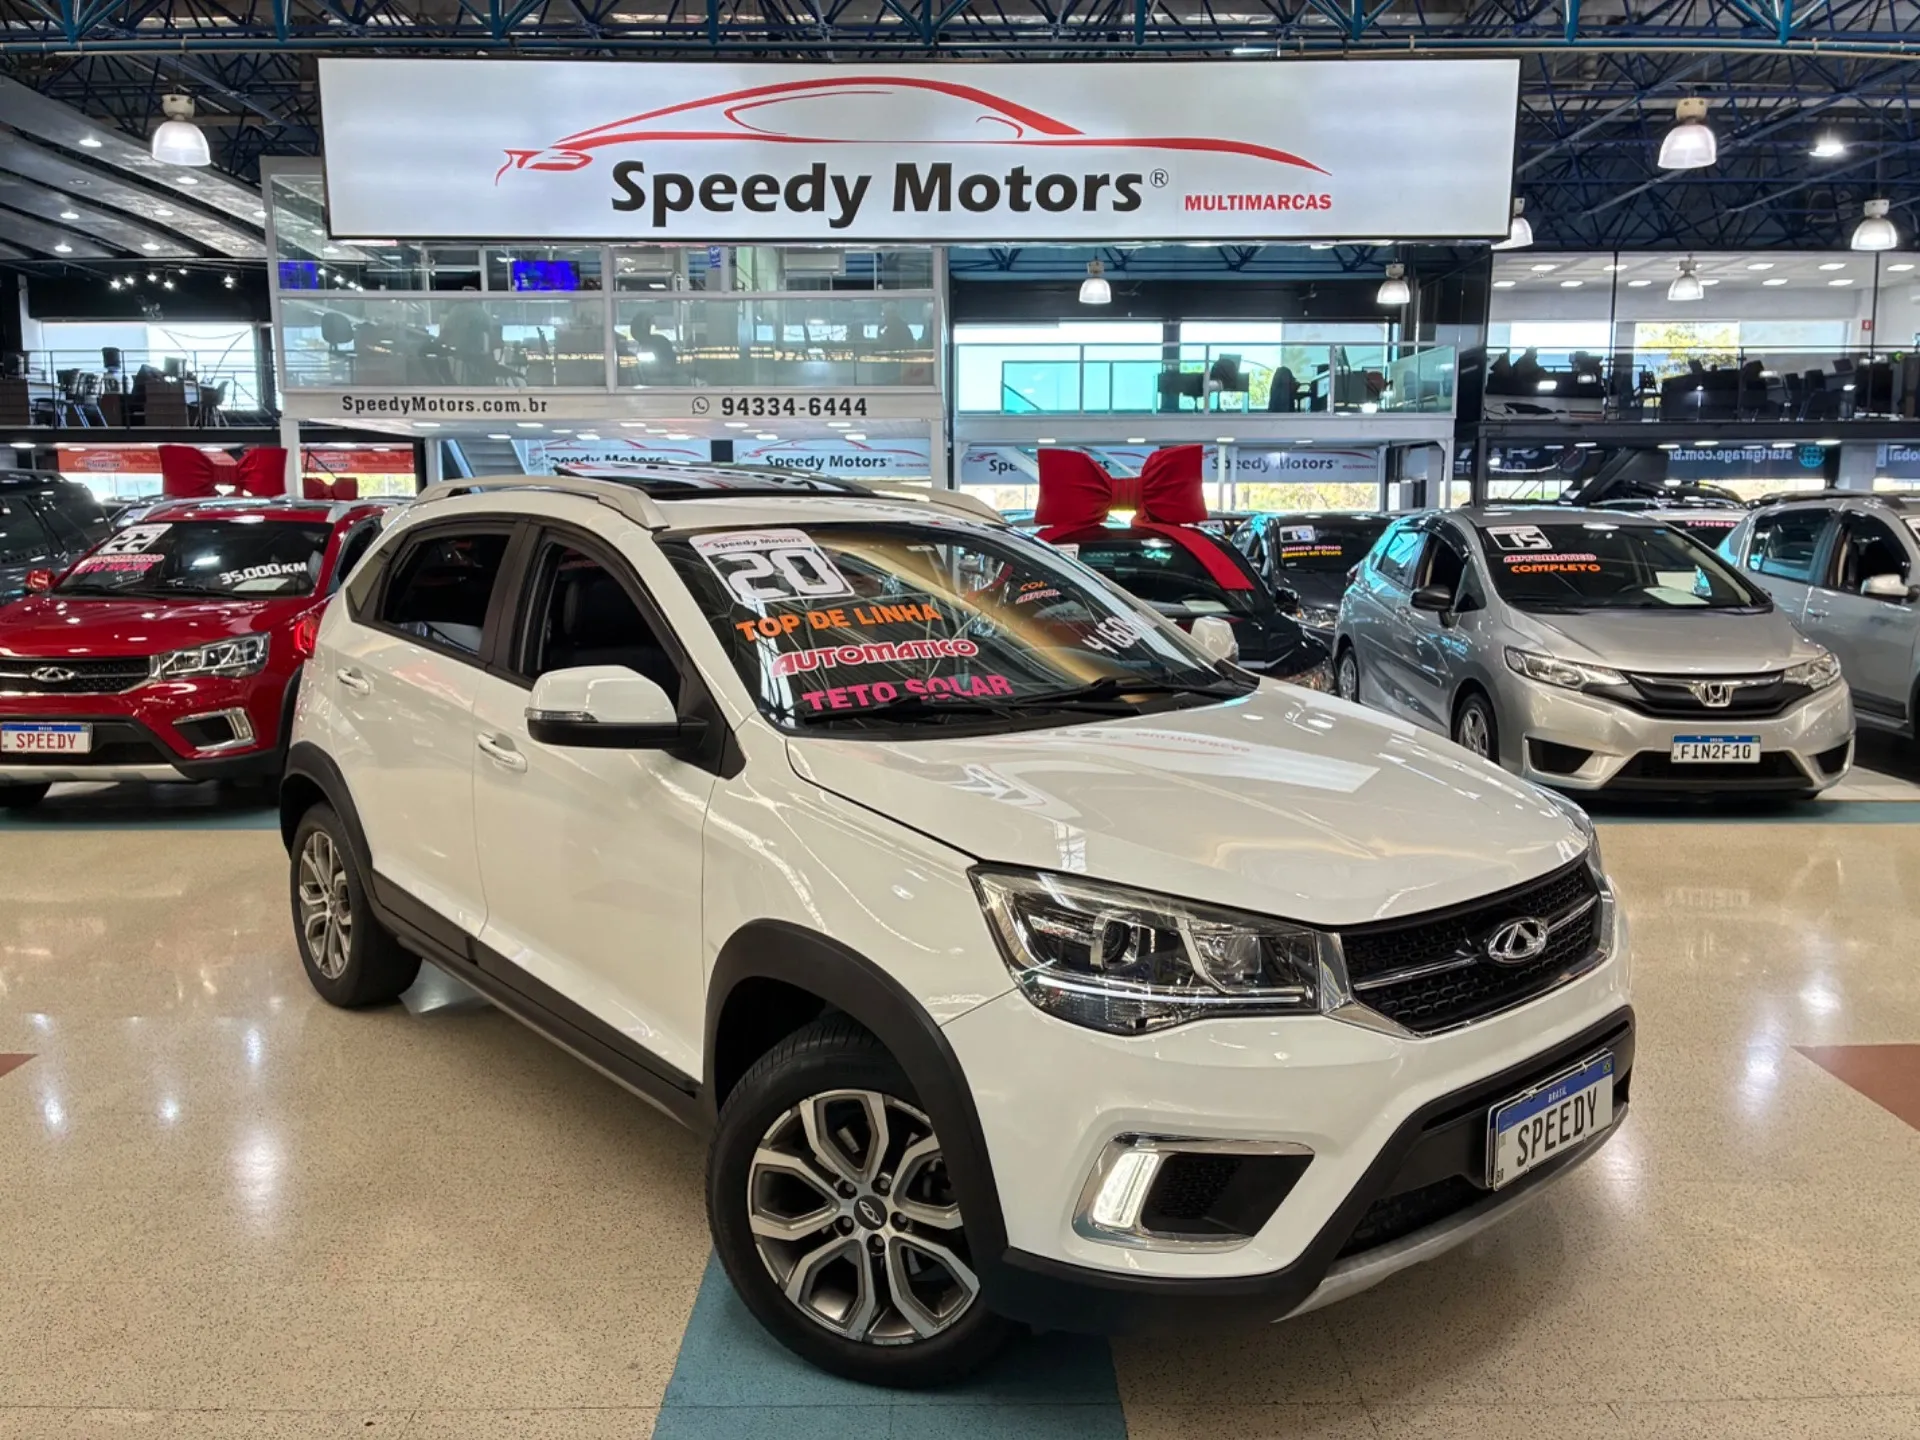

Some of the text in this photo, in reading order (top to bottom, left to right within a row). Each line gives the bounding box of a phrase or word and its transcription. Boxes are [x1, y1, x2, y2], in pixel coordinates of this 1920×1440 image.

[611, 160, 872, 229] Speedy
[1184, 194, 1332, 211] MULTIMARCAS
[342, 396, 548, 415] SpeedyMotors.com.br
[721, 397, 867, 416] 94334-6444
[766, 455, 825, 471] Speedy
[714, 536, 803, 549] Speedy Motors
[719, 550, 845, 598] 20
[1511, 564, 1601, 573] COMPLETO
[735, 603, 943, 642] TOP DE LINHA
[771, 639, 979, 679] AUTOMATICO
[802, 675, 1015, 711] TETO SOLAR
[16, 733, 77, 749] SPEEDY
[1681, 744, 1752, 760] FIN2F10
[1517, 1086, 1597, 1167] SPEEDY
